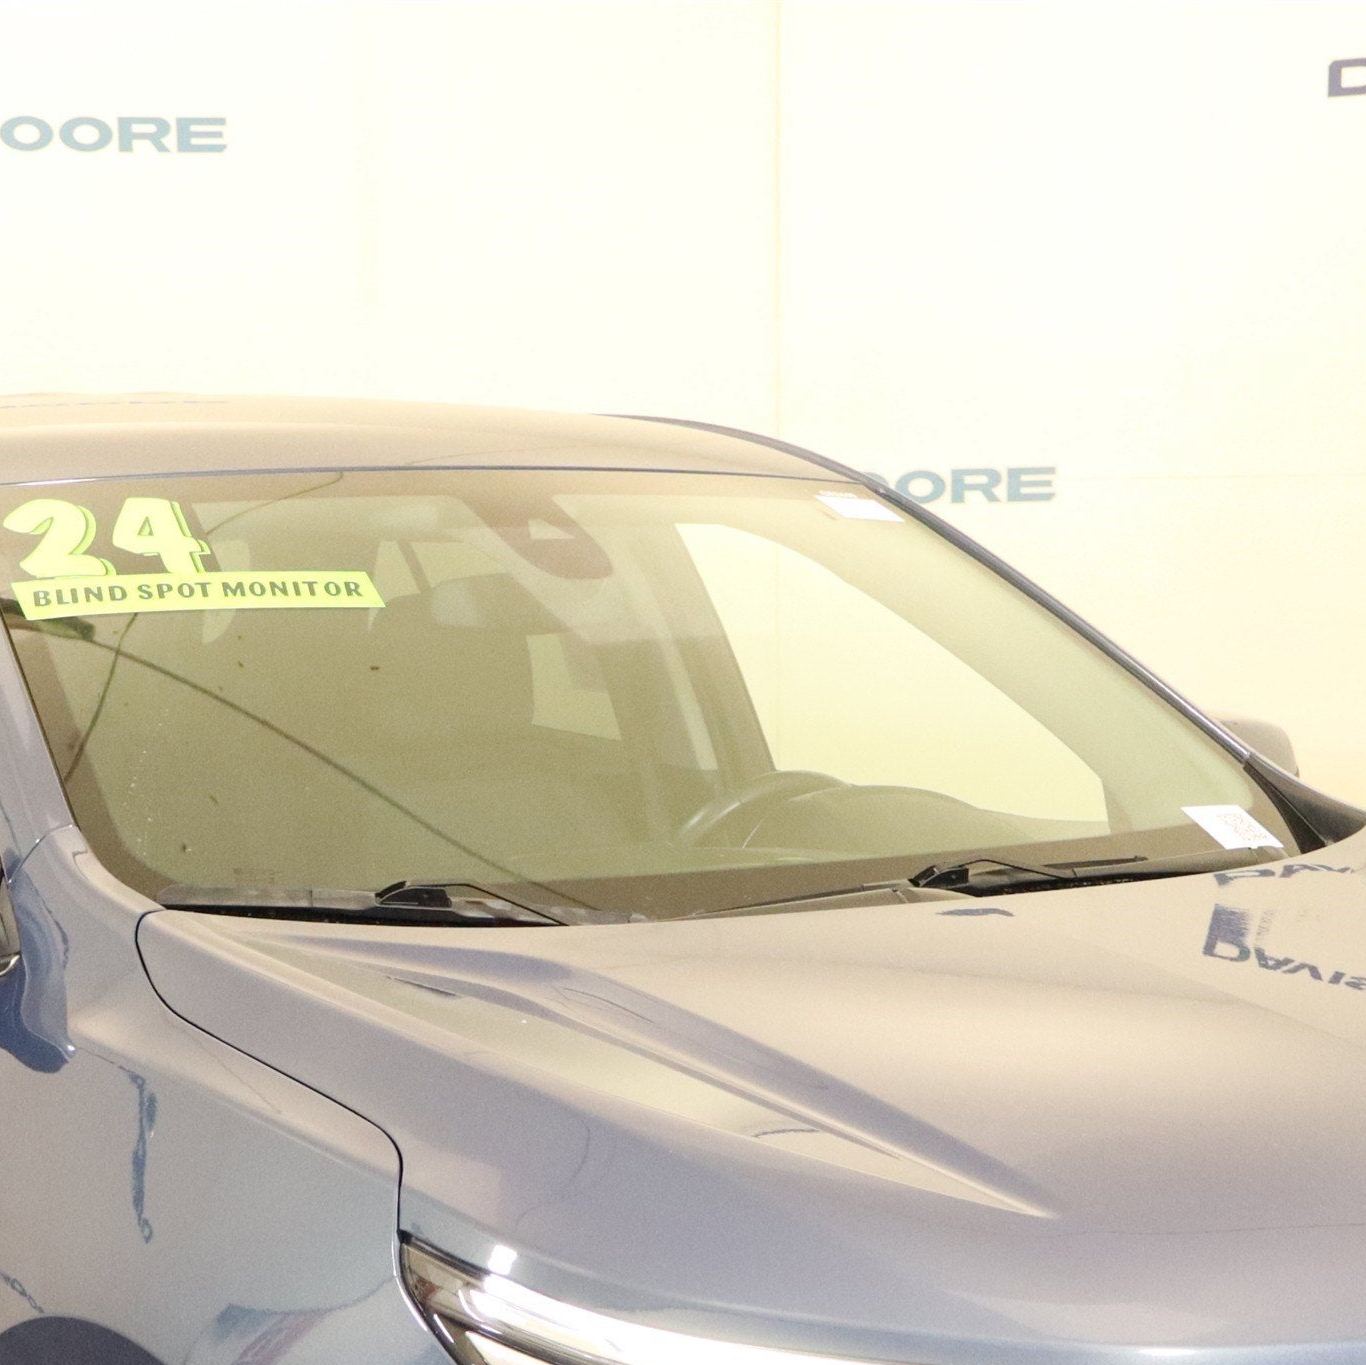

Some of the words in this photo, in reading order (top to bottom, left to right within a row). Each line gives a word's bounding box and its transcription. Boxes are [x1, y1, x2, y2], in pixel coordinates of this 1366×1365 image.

[865, 467, 1056, 504] ORE
[3, 497, 210, 578] 24
[32, 584, 128, 607] BLIND
[137, 581, 212, 601] SPOT
[222, 580, 363, 599] MONITOR
